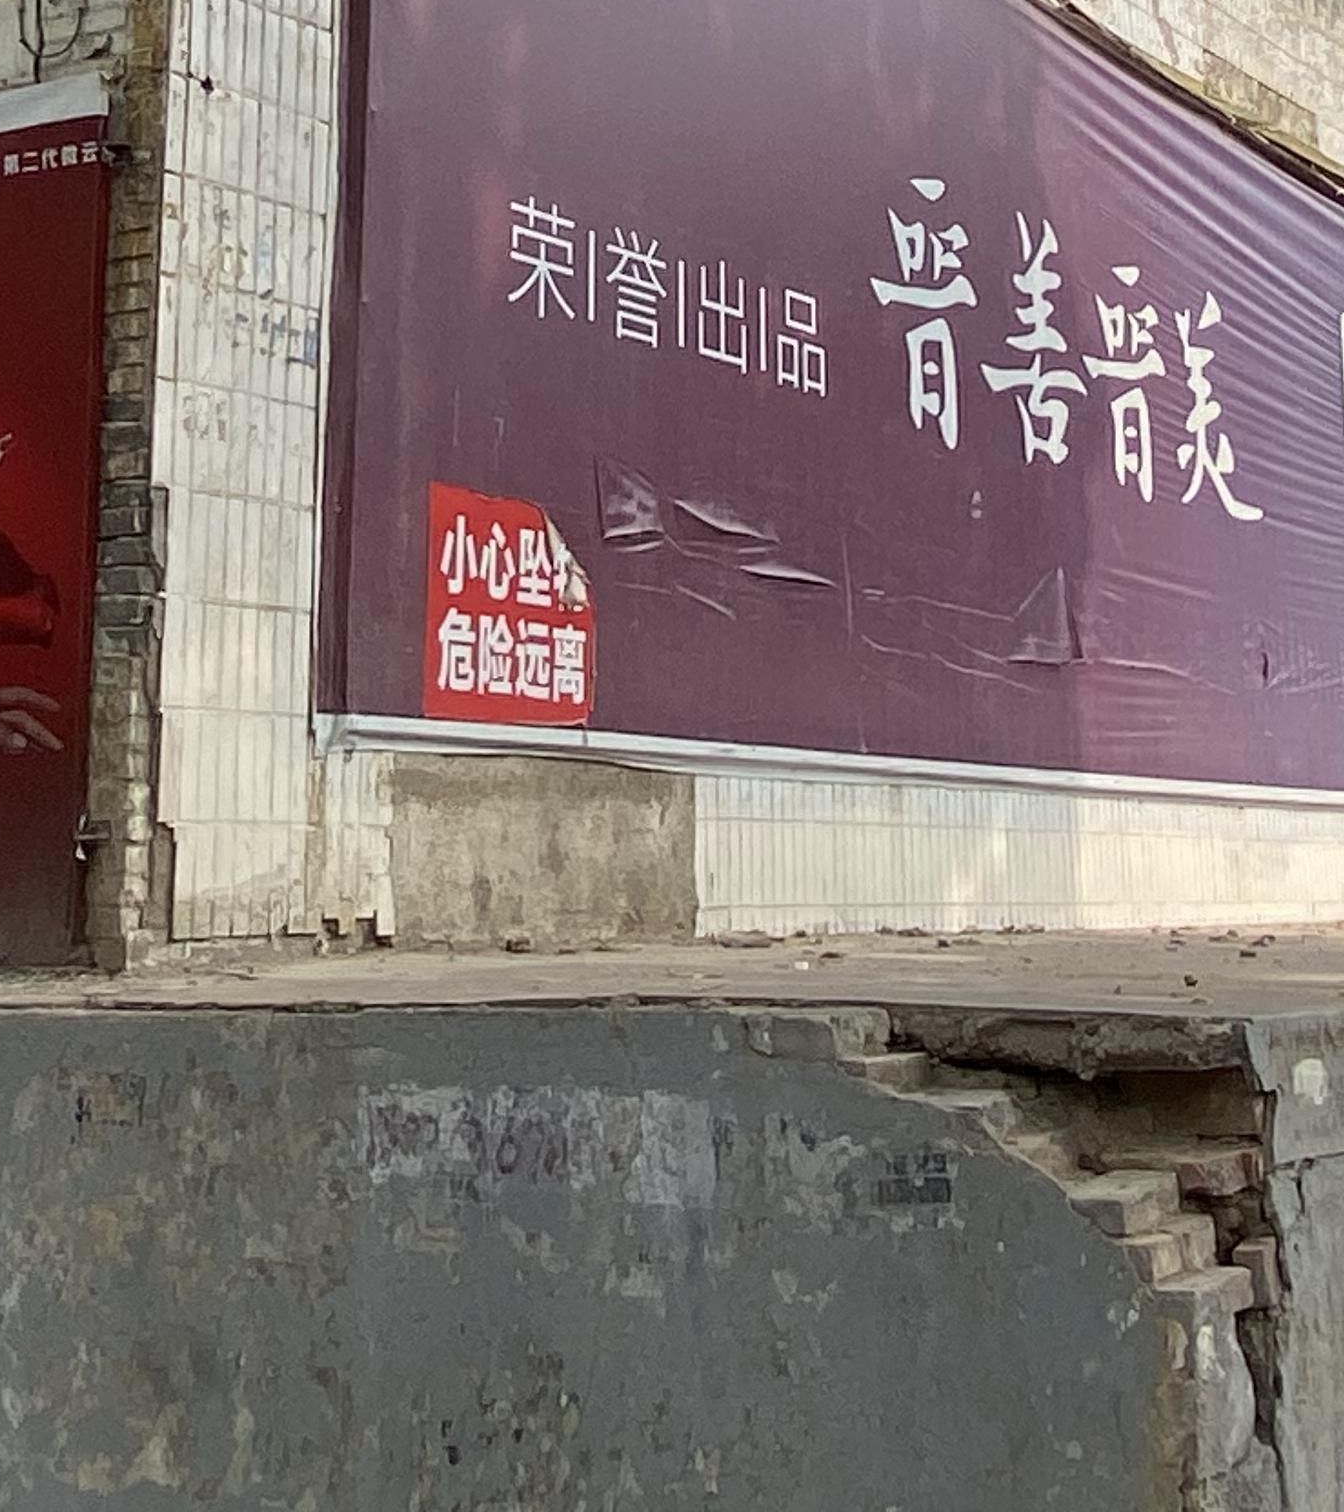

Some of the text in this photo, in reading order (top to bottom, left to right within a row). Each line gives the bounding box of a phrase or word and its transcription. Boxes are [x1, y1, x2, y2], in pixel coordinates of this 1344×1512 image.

[441, 514, 586, 612] 小心坠
[438, 608, 586, 704] 危险远离
